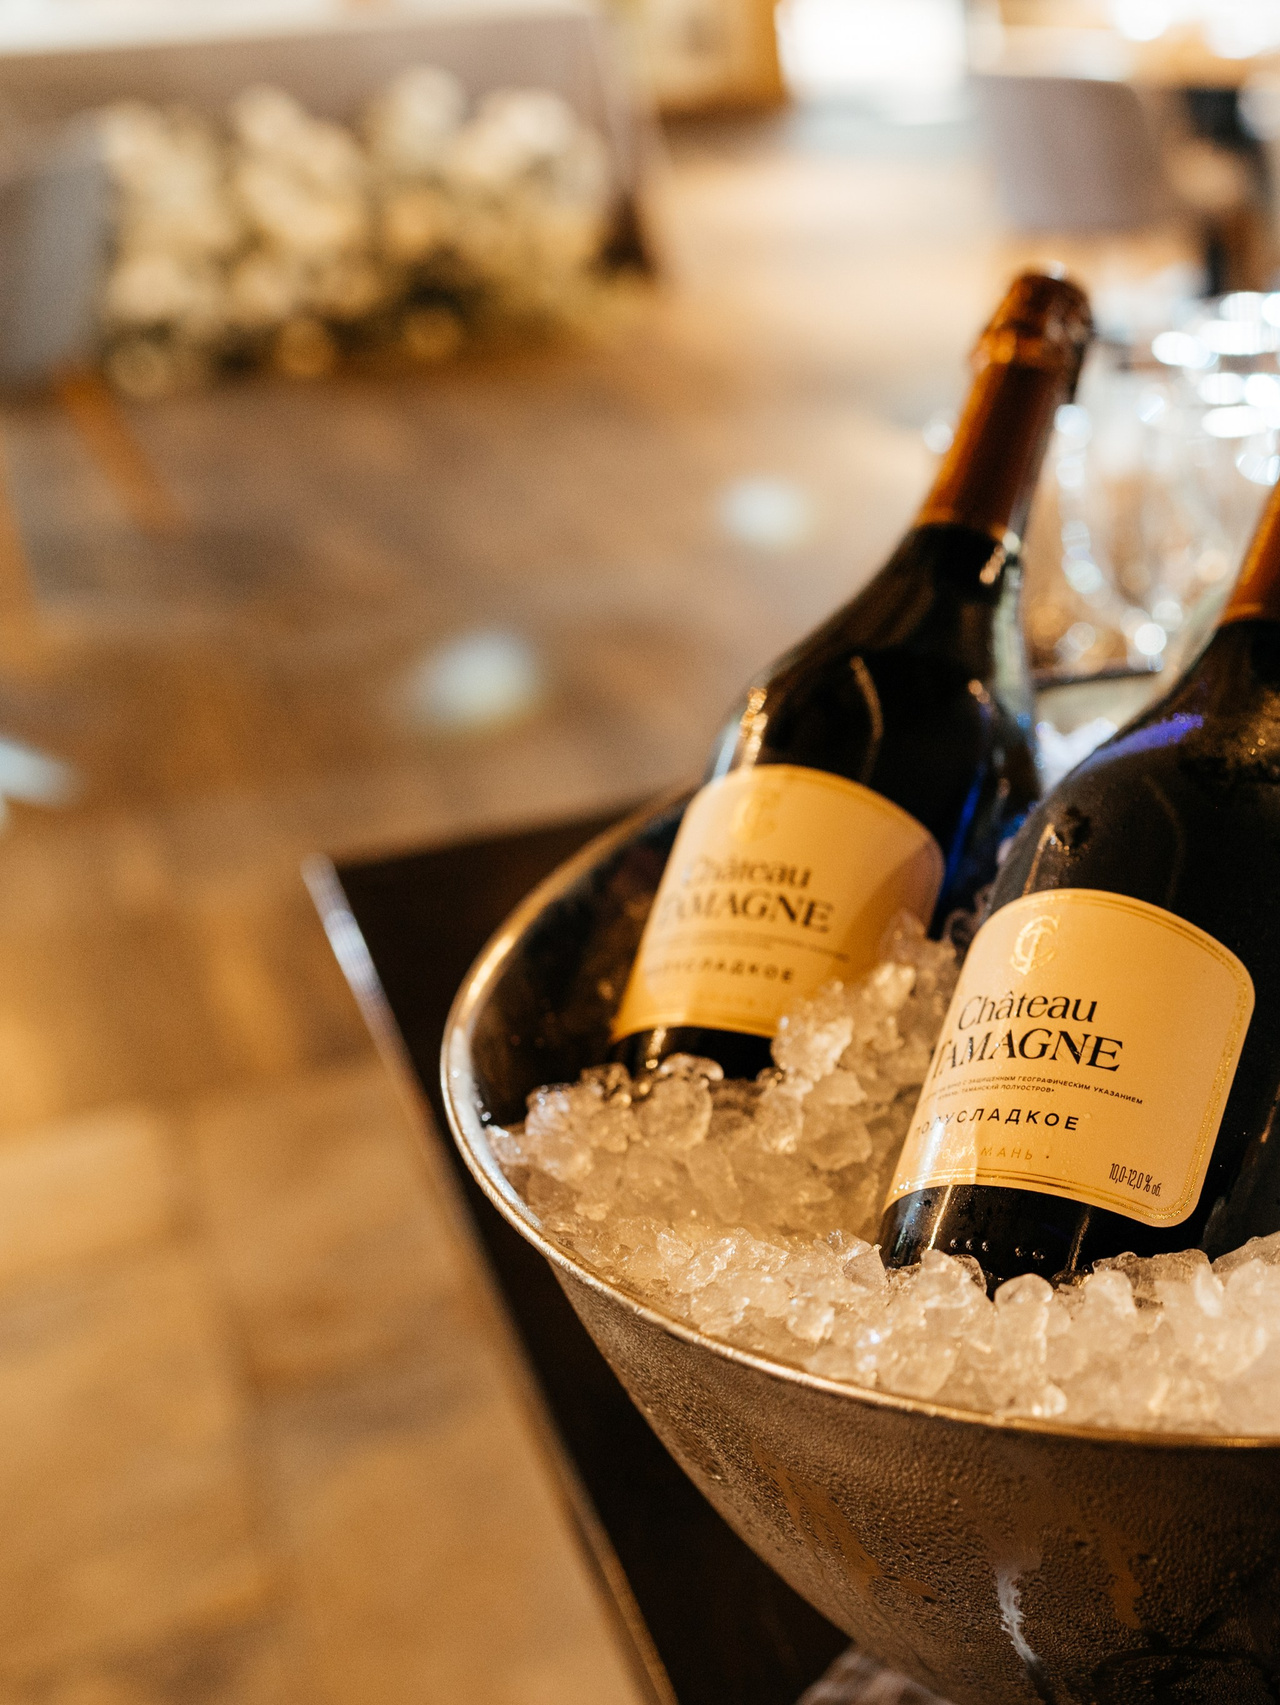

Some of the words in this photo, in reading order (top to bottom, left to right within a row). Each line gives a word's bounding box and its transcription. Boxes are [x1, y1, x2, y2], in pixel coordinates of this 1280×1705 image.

[958, 991, 1098, 1031] Château
[1018, 1075, 1091, 1091] ГЕОГРАФИЧЕСКИМ
[1093, 1086, 1144, 1105] УКАЗАНИЕМ
[1109, 1163, 1145, 1190] 10,0-12,0
[1143, 1174, 1153, 1192] %
